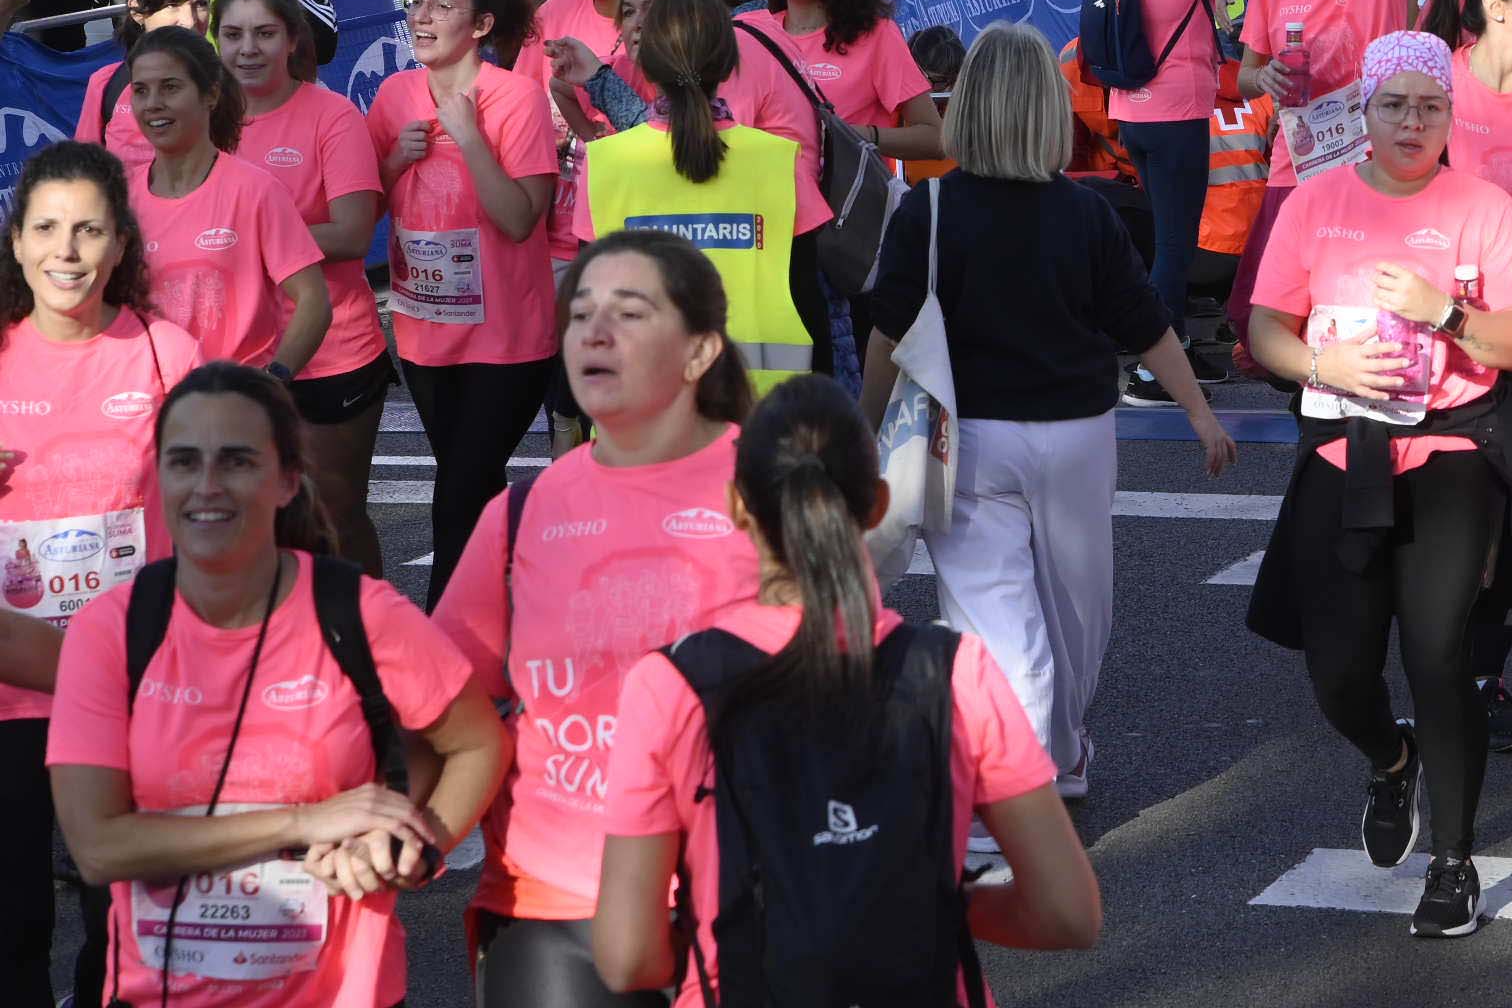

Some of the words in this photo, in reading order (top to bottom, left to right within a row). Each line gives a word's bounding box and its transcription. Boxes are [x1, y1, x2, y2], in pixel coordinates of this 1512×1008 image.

[1316, 123, 1345, 143] 016
[1316, 225, 1366, 242] OYSHO
[410, 266, 443, 282] 016
[414, 282, 440, 294] 21627
[0, 400, 51, 417] YSHO
[542, 517, 607, 542] OYSHO
[49, 570, 101, 594] 016
[526, 657, 574, 698] TU
[195, 872, 261, 897] 016
[200, 903, 251, 921] 22263
[203, 926, 218, 938] DE
[220, 927, 235, 938] LA
[238, 927, 278, 938] MUJER
[251, 952, 310, 965] Santander
